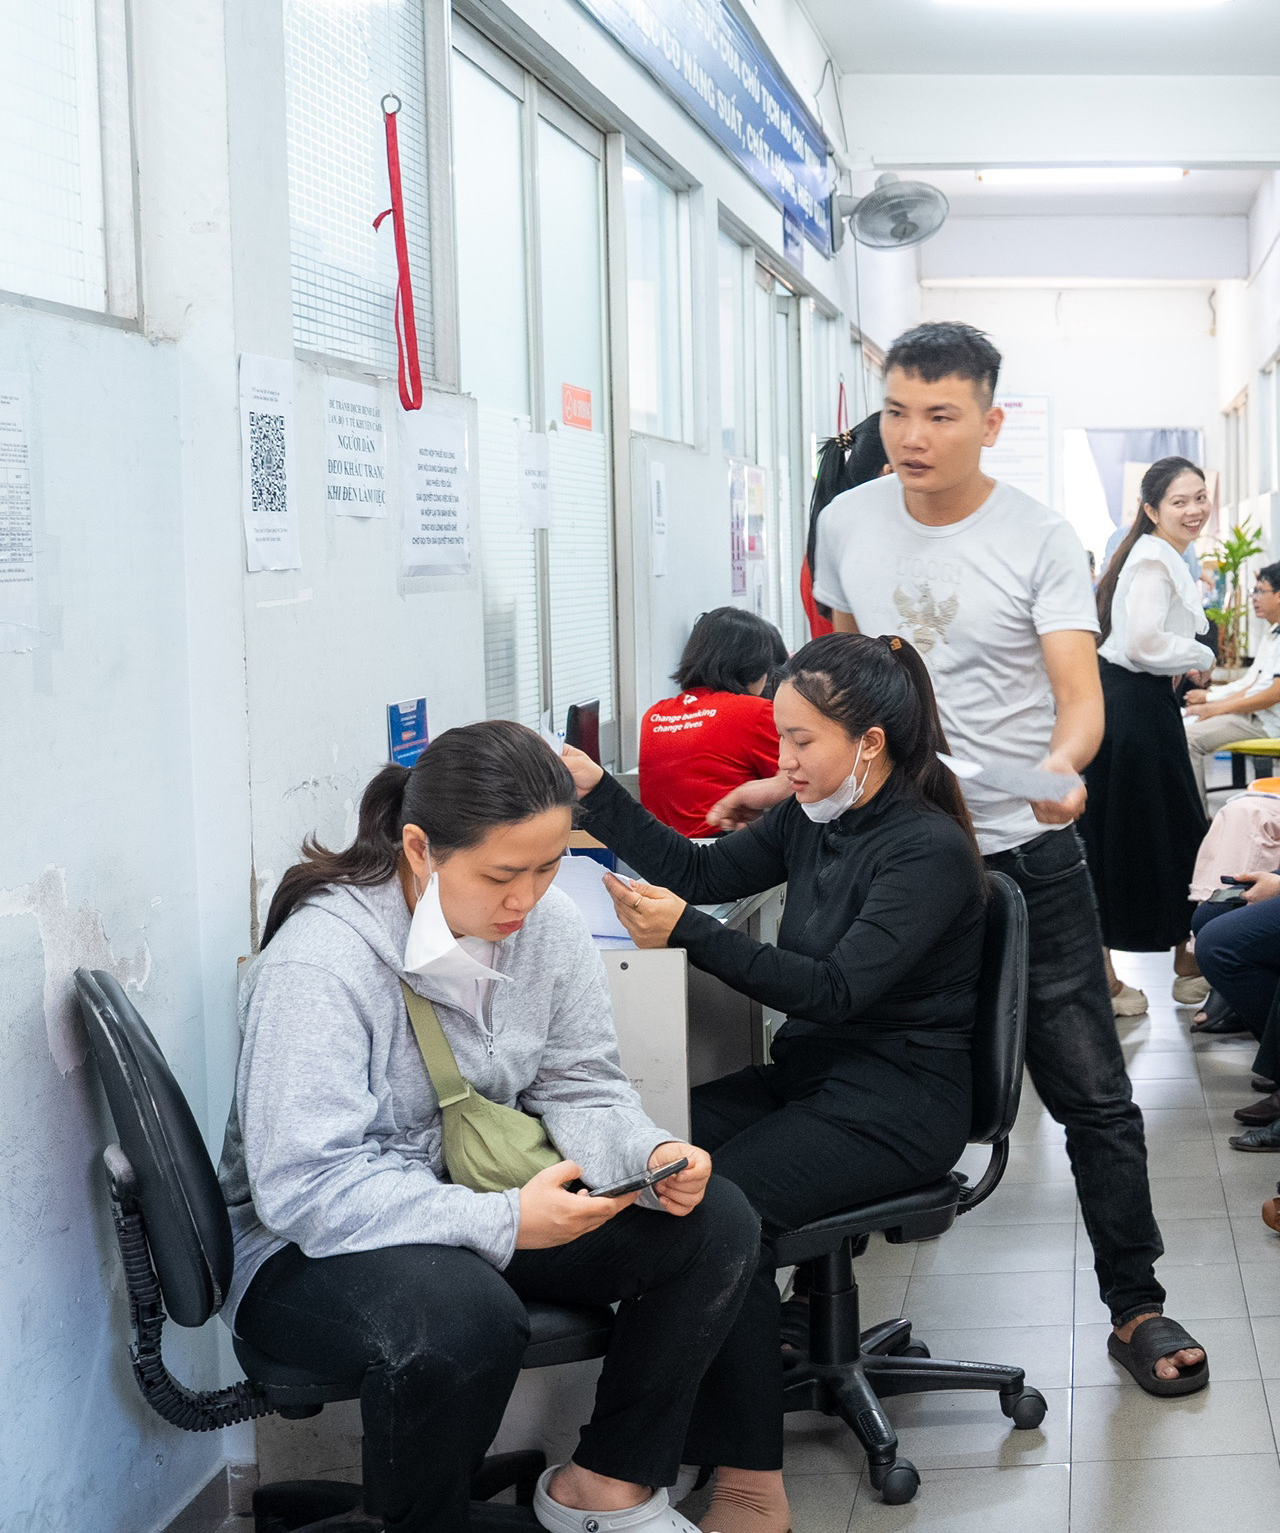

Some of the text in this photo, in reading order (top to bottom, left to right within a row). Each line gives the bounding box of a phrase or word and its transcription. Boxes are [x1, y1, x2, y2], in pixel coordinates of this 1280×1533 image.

[337, 430, 376, 454] NGƯỜI DÂN
[327, 459, 343, 475] ĐEO
[364, 463, 385, 480] TRANG
[327, 485, 342, 501] KHI
[342, 482, 358, 502] ĐẾN
[650, 708, 717, 723] Change banking
[653, 720, 703, 733] change lives
